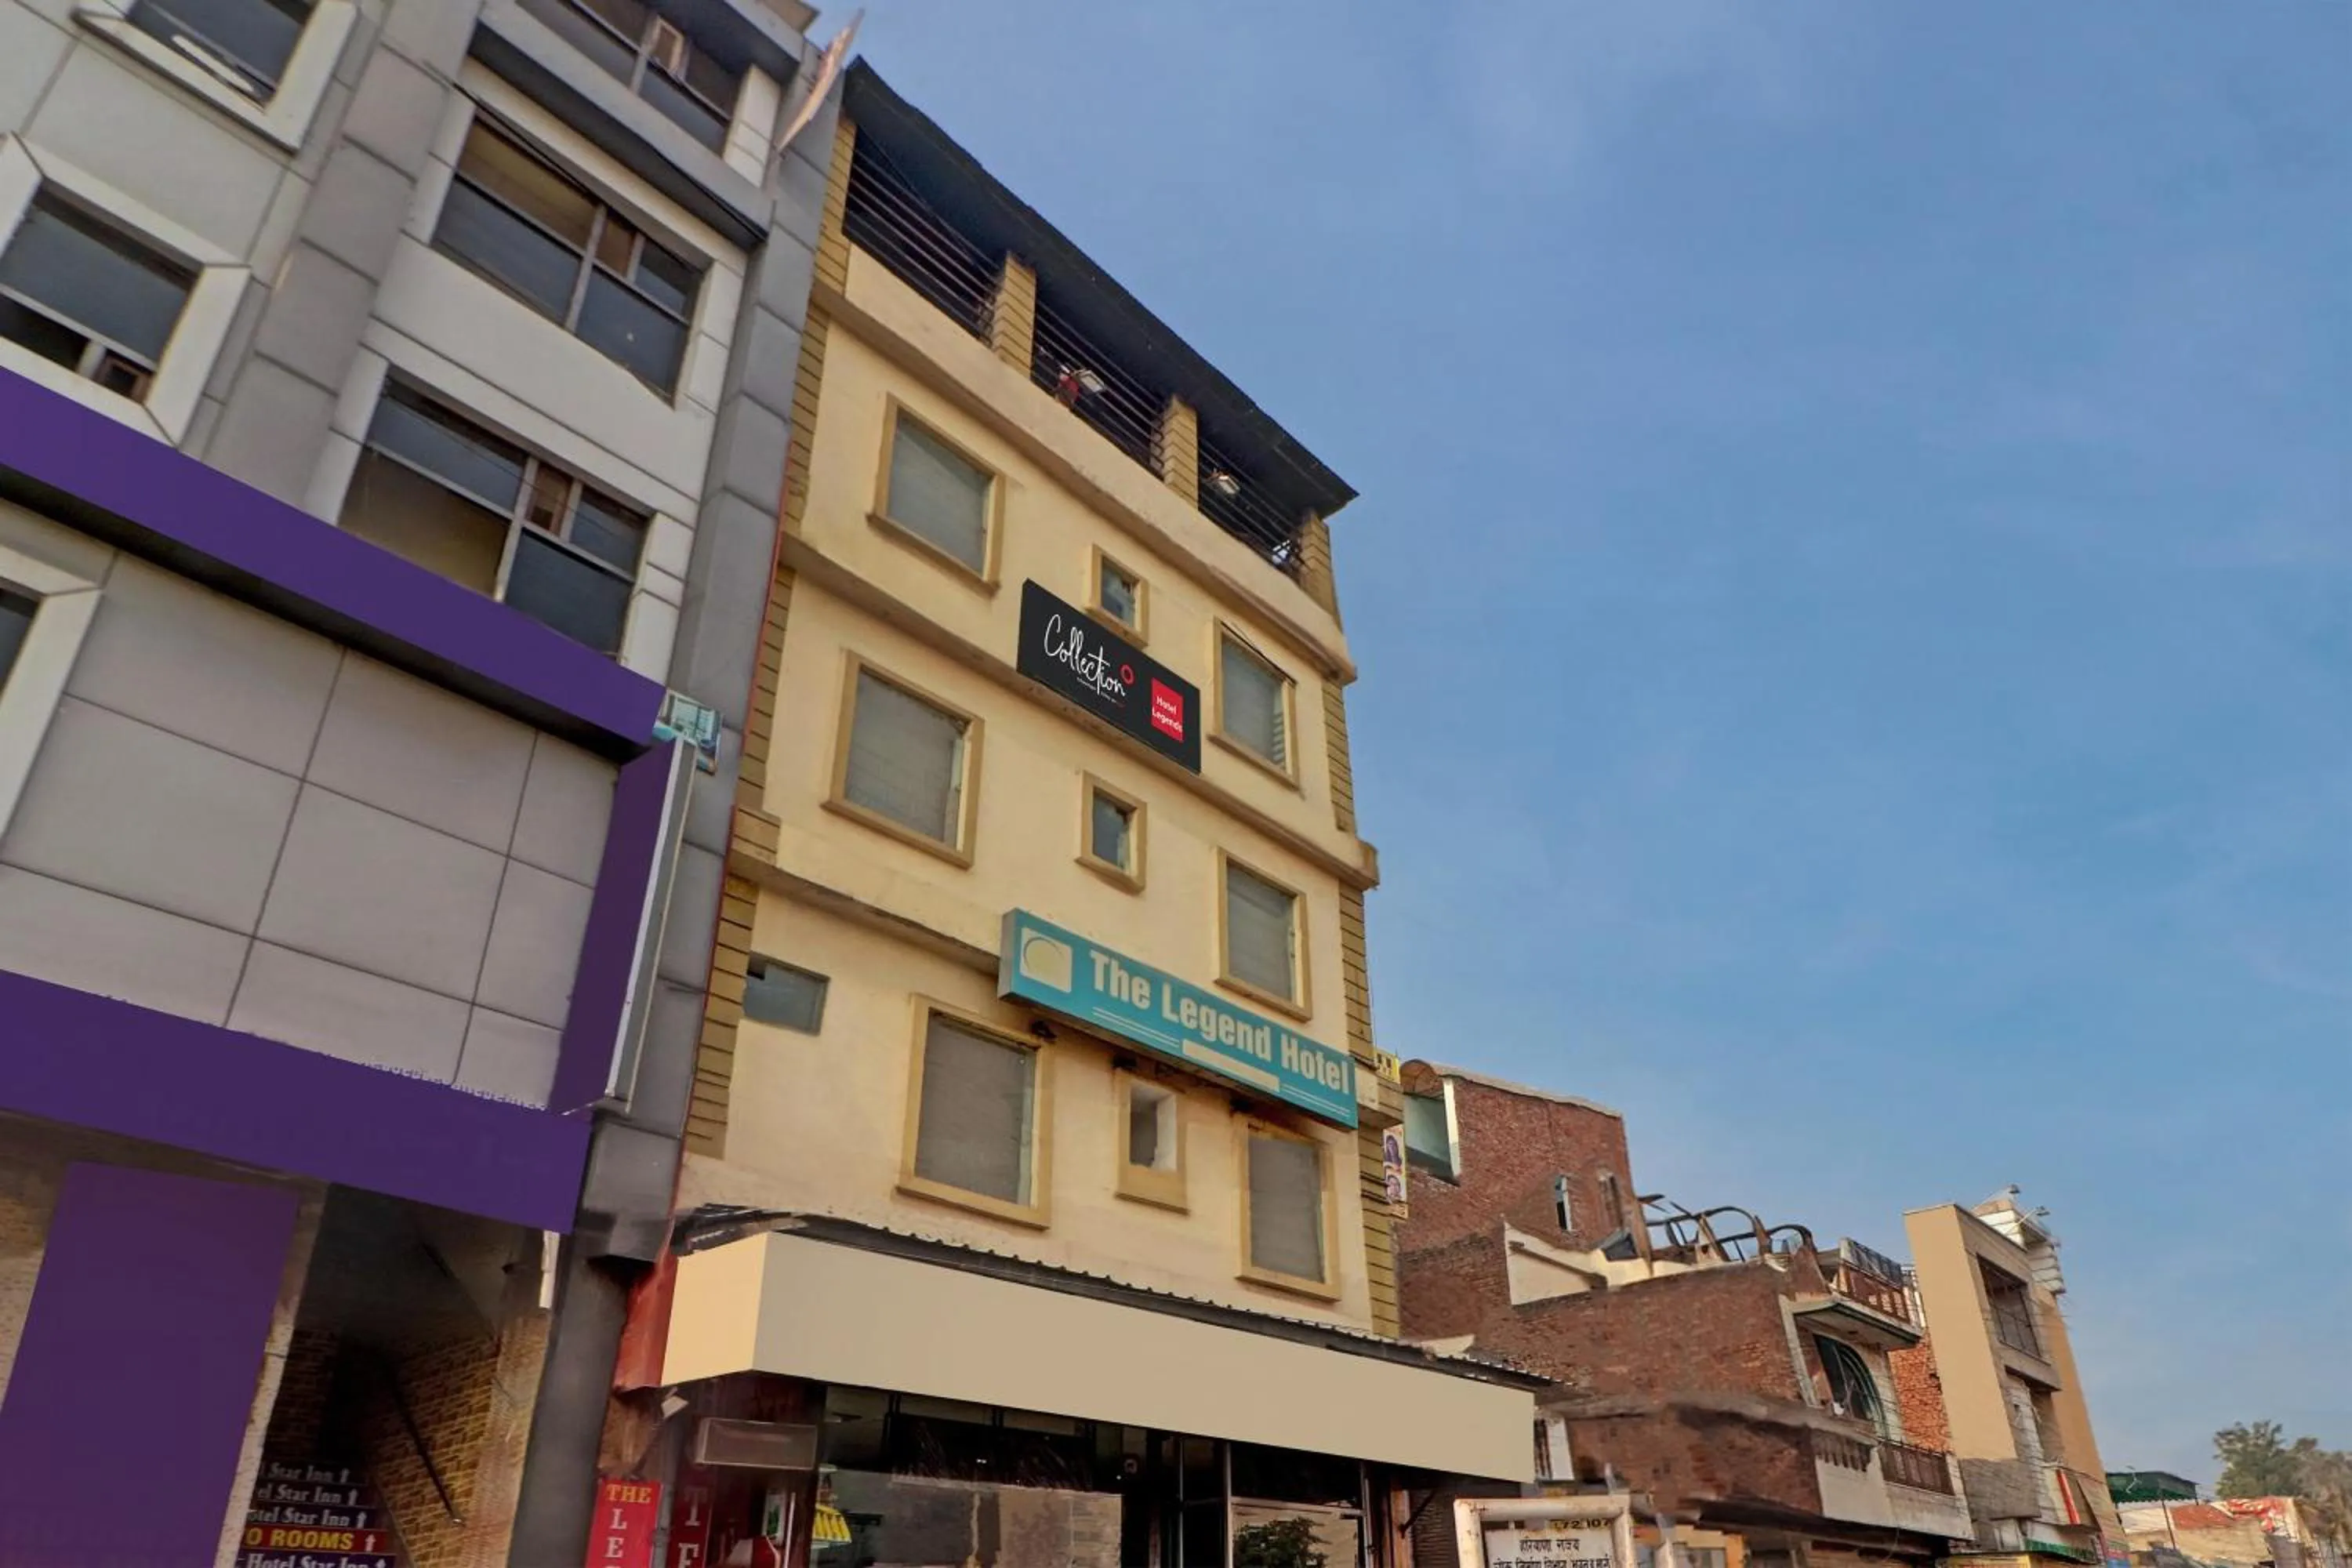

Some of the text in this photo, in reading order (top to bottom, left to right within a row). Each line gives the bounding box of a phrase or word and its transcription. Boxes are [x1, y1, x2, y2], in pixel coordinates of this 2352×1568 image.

[1044, 614, 1126, 696] Collection
[1090, 950, 1349, 1095] The Legend Hotel
[276, 1484, 310, 1501] Star
[314, 1486, 342, 1504] Inn
[606, 1483, 653, 1504] THE
[282, 1508, 319, 1525] Star
[321, 1510, 350, 1527] Inn
[270, 1530, 354, 1549] ROOMS
[247, 1552, 296, 1568] Hotel
